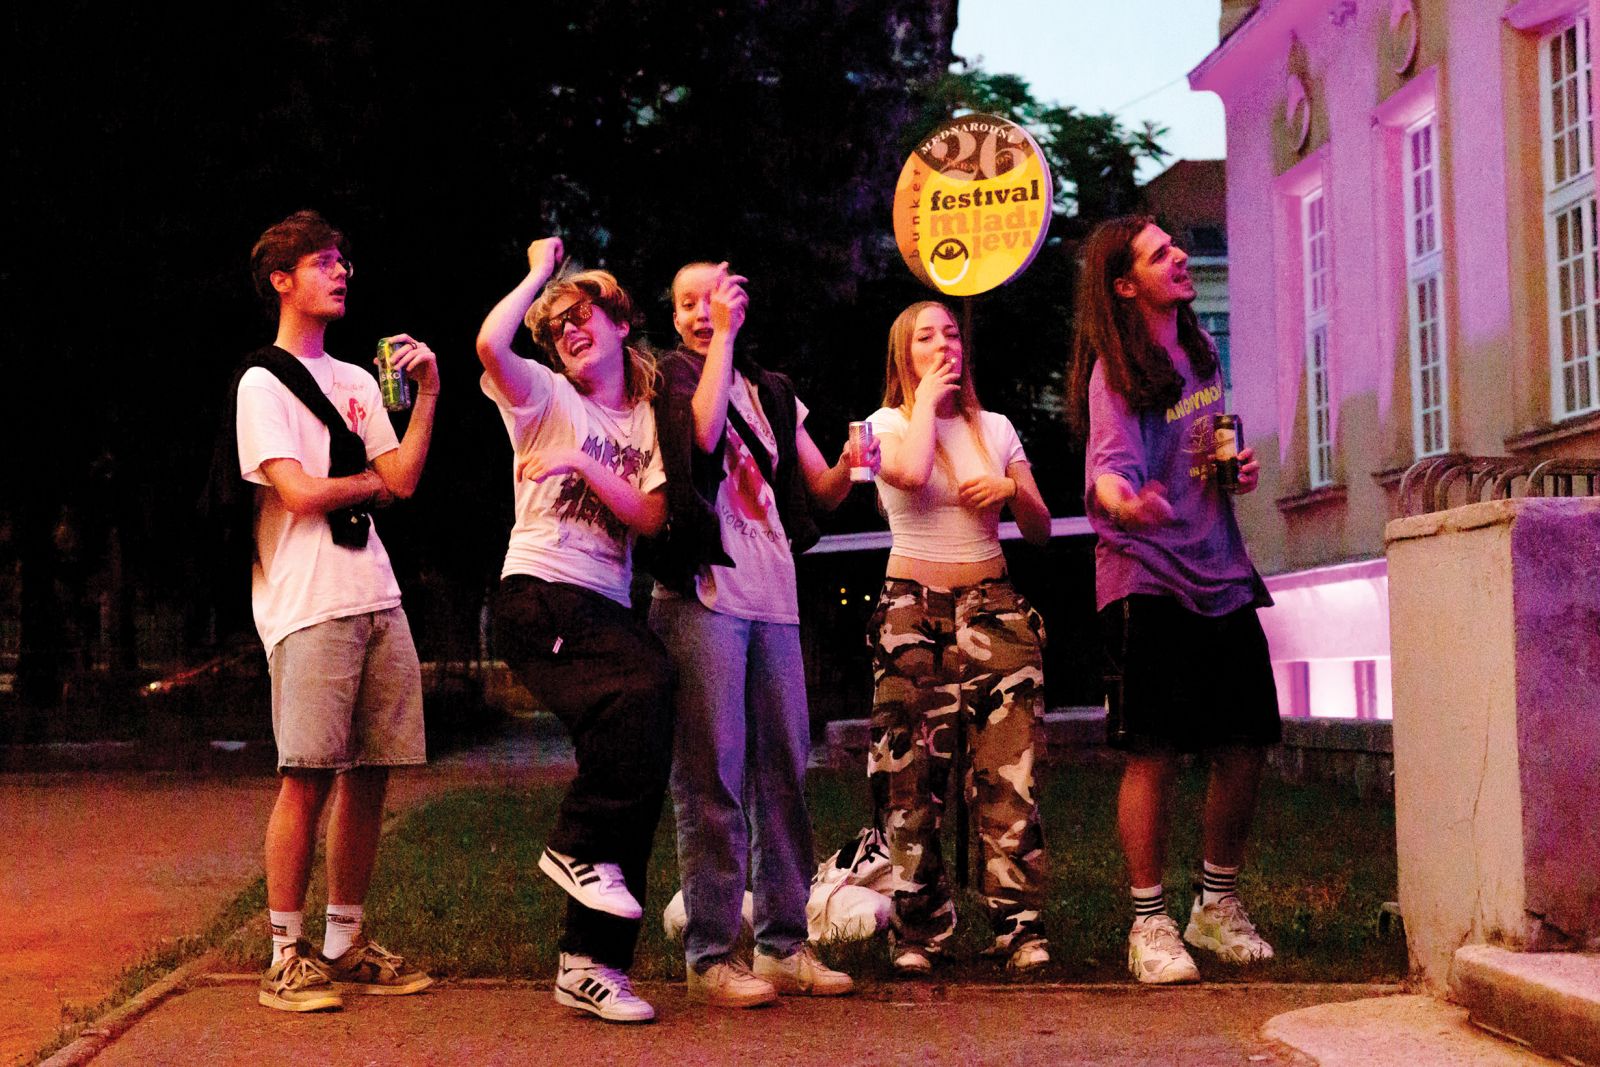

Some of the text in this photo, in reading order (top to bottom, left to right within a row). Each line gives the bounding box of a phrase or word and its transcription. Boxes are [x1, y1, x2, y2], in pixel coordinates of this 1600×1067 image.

[920, 122, 1015, 155] MEDNARODNI
[930, 125, 1029, 182] 26
[930, 179, 1040, 212] festival
[909, 168, 921, 260] bunker
[930, 204, 1039, 237] mladi
